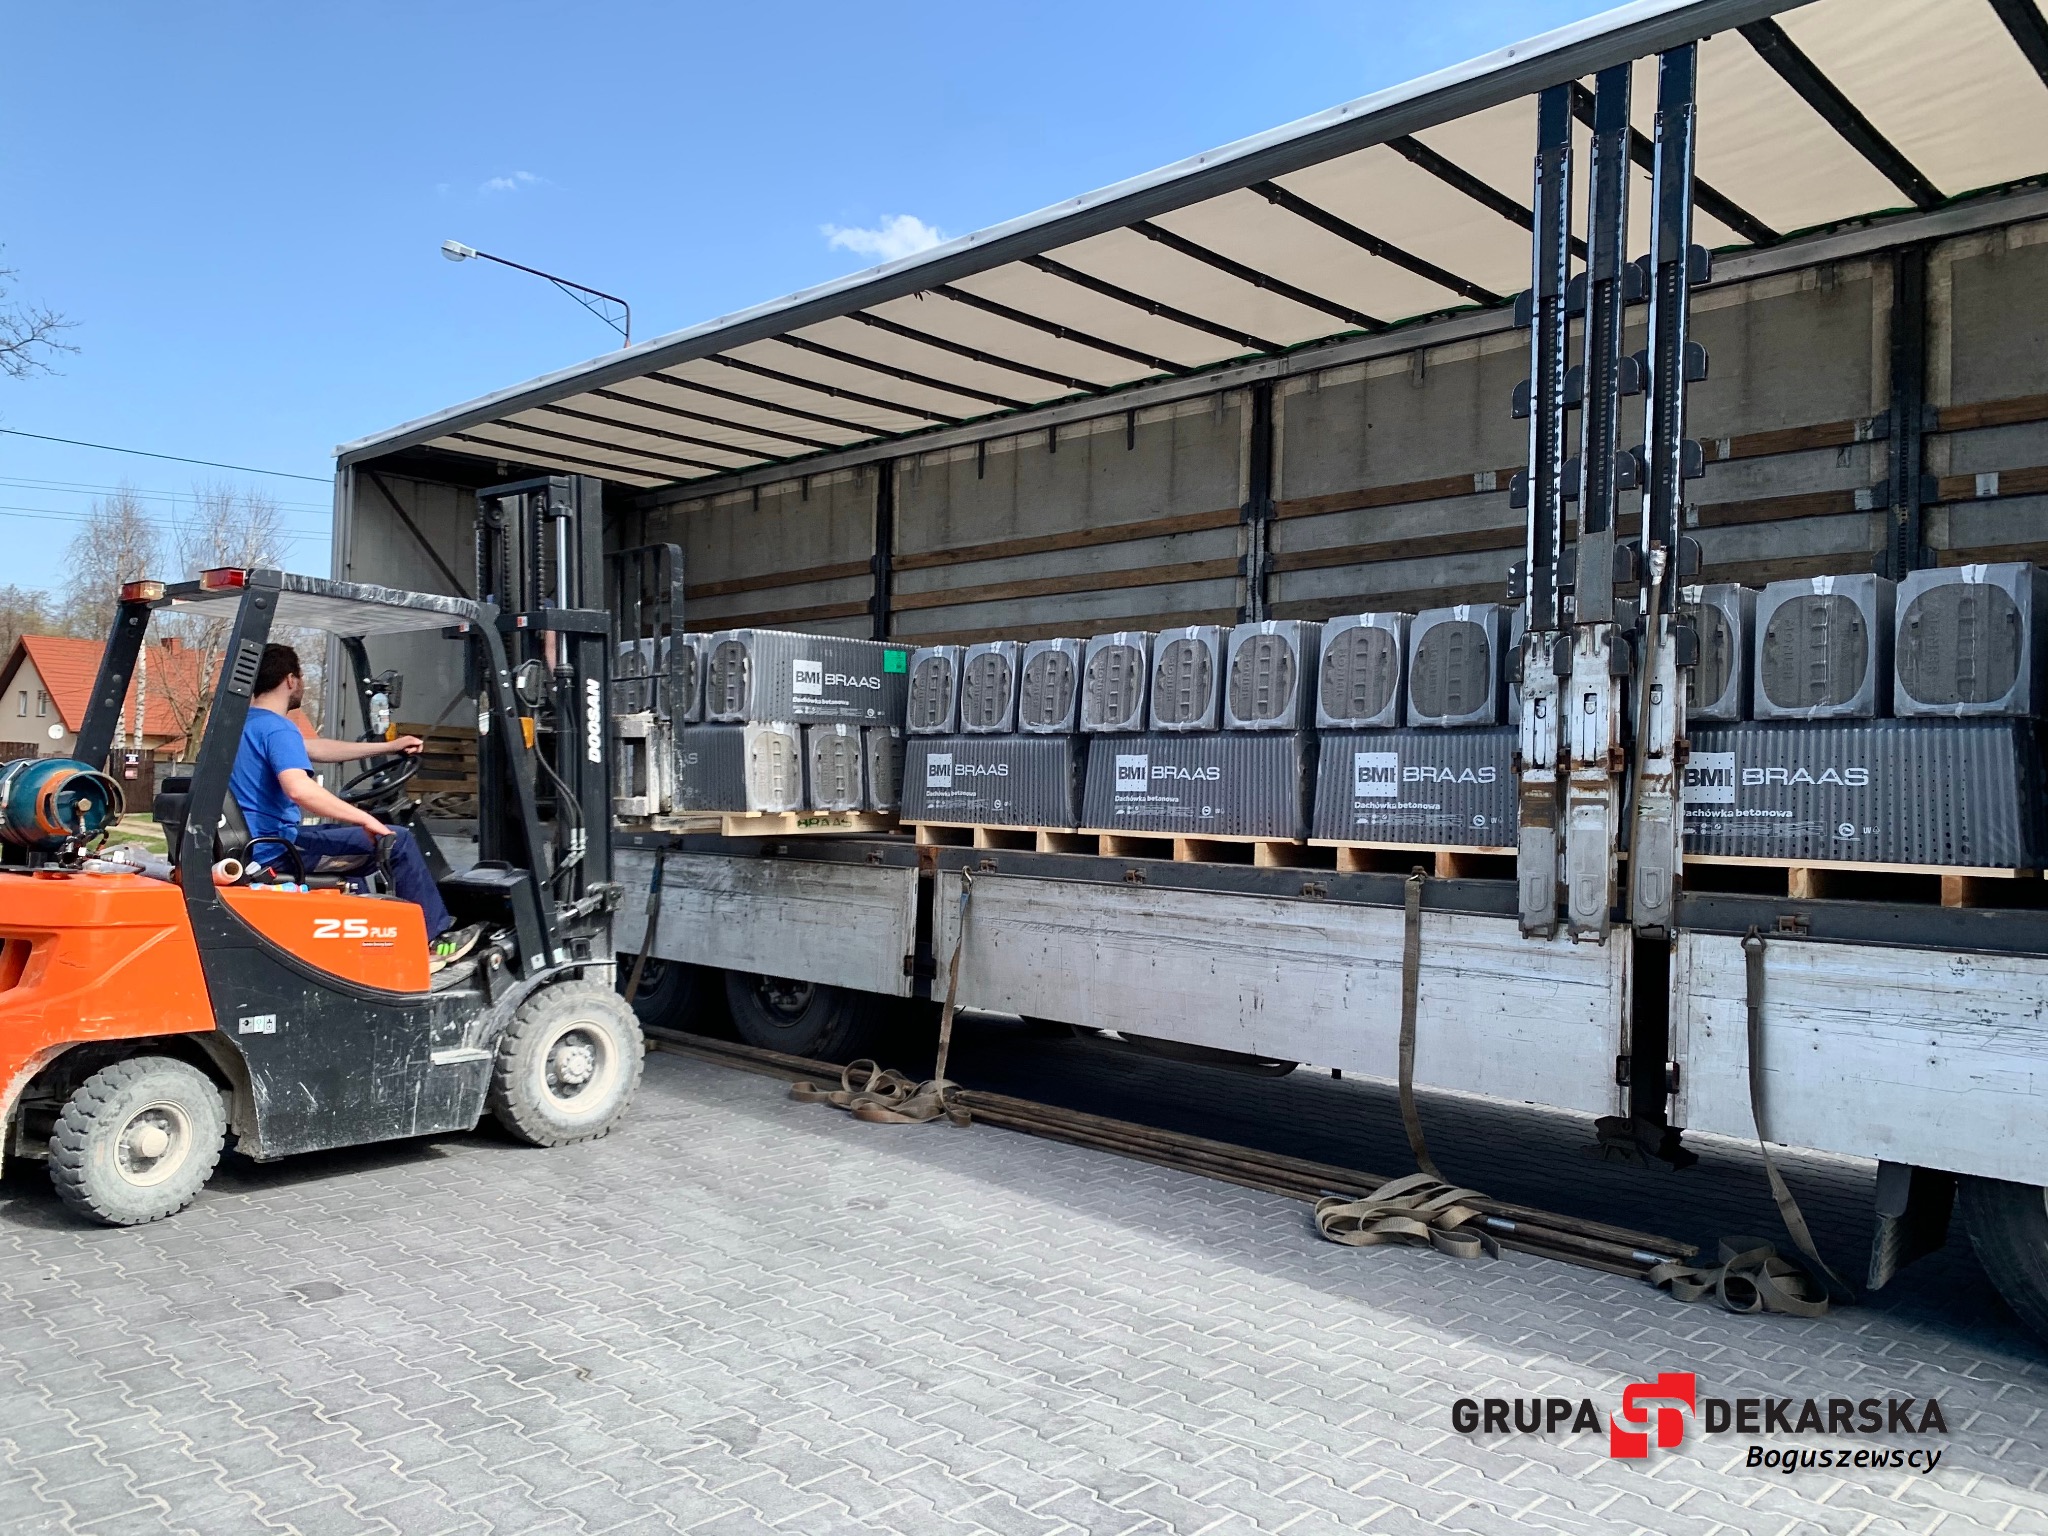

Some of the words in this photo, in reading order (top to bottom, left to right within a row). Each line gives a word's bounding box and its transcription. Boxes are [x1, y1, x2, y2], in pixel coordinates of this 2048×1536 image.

[795, 670, 821, 685] BMI
[824, 673, 881, 690] BRAAS
[586, 678, 602, 764] DOOSAN
[928, 764, 951, 777] BMI
[954, 763, 1009, 777] BRAAS
[1118, 766, 1147, 780] BMI
[1151, 765, 1220, 781] BRAAS
[1358, 766, 1396, 783] BMI
[1402, 766, 1497, 784] BRAAS
[1684, 768, 1732, 787] BMI
[1742, 767, 1870, 787] BRAAS
[1354, 801, 1397, 810] Dachówka
[1397, 801, 1441, 811] betonowa
[1735, 808, 1793, 818] betonowa
[313, 918, 369, 939] 25
[369, 926, 398, 938] PLUS
